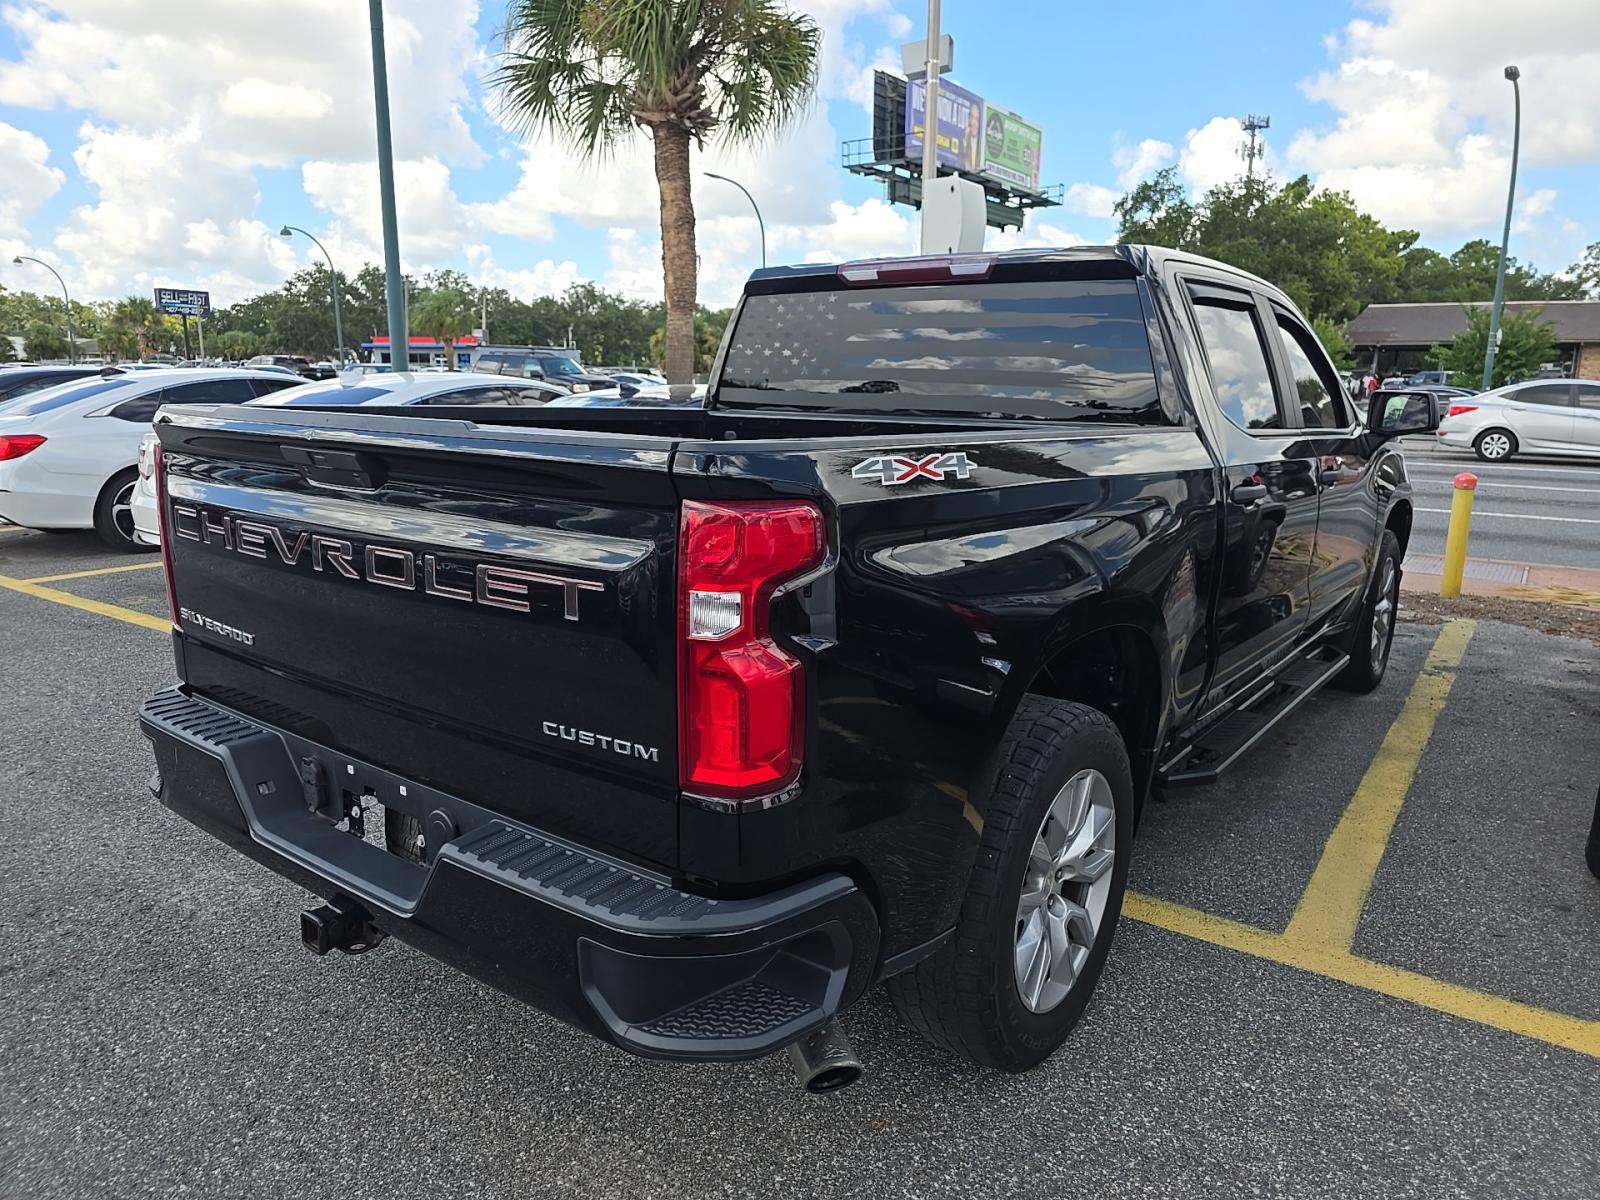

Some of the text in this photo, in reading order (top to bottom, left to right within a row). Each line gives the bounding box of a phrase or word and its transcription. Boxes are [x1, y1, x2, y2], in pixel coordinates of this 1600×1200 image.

[161, 291, 178, 300] SELL
[173, 505, 605, 622] CHEVROLET
[180, 607, 255, 646] SILVERADO
[542, 721, 659, 762] CUSTOM
